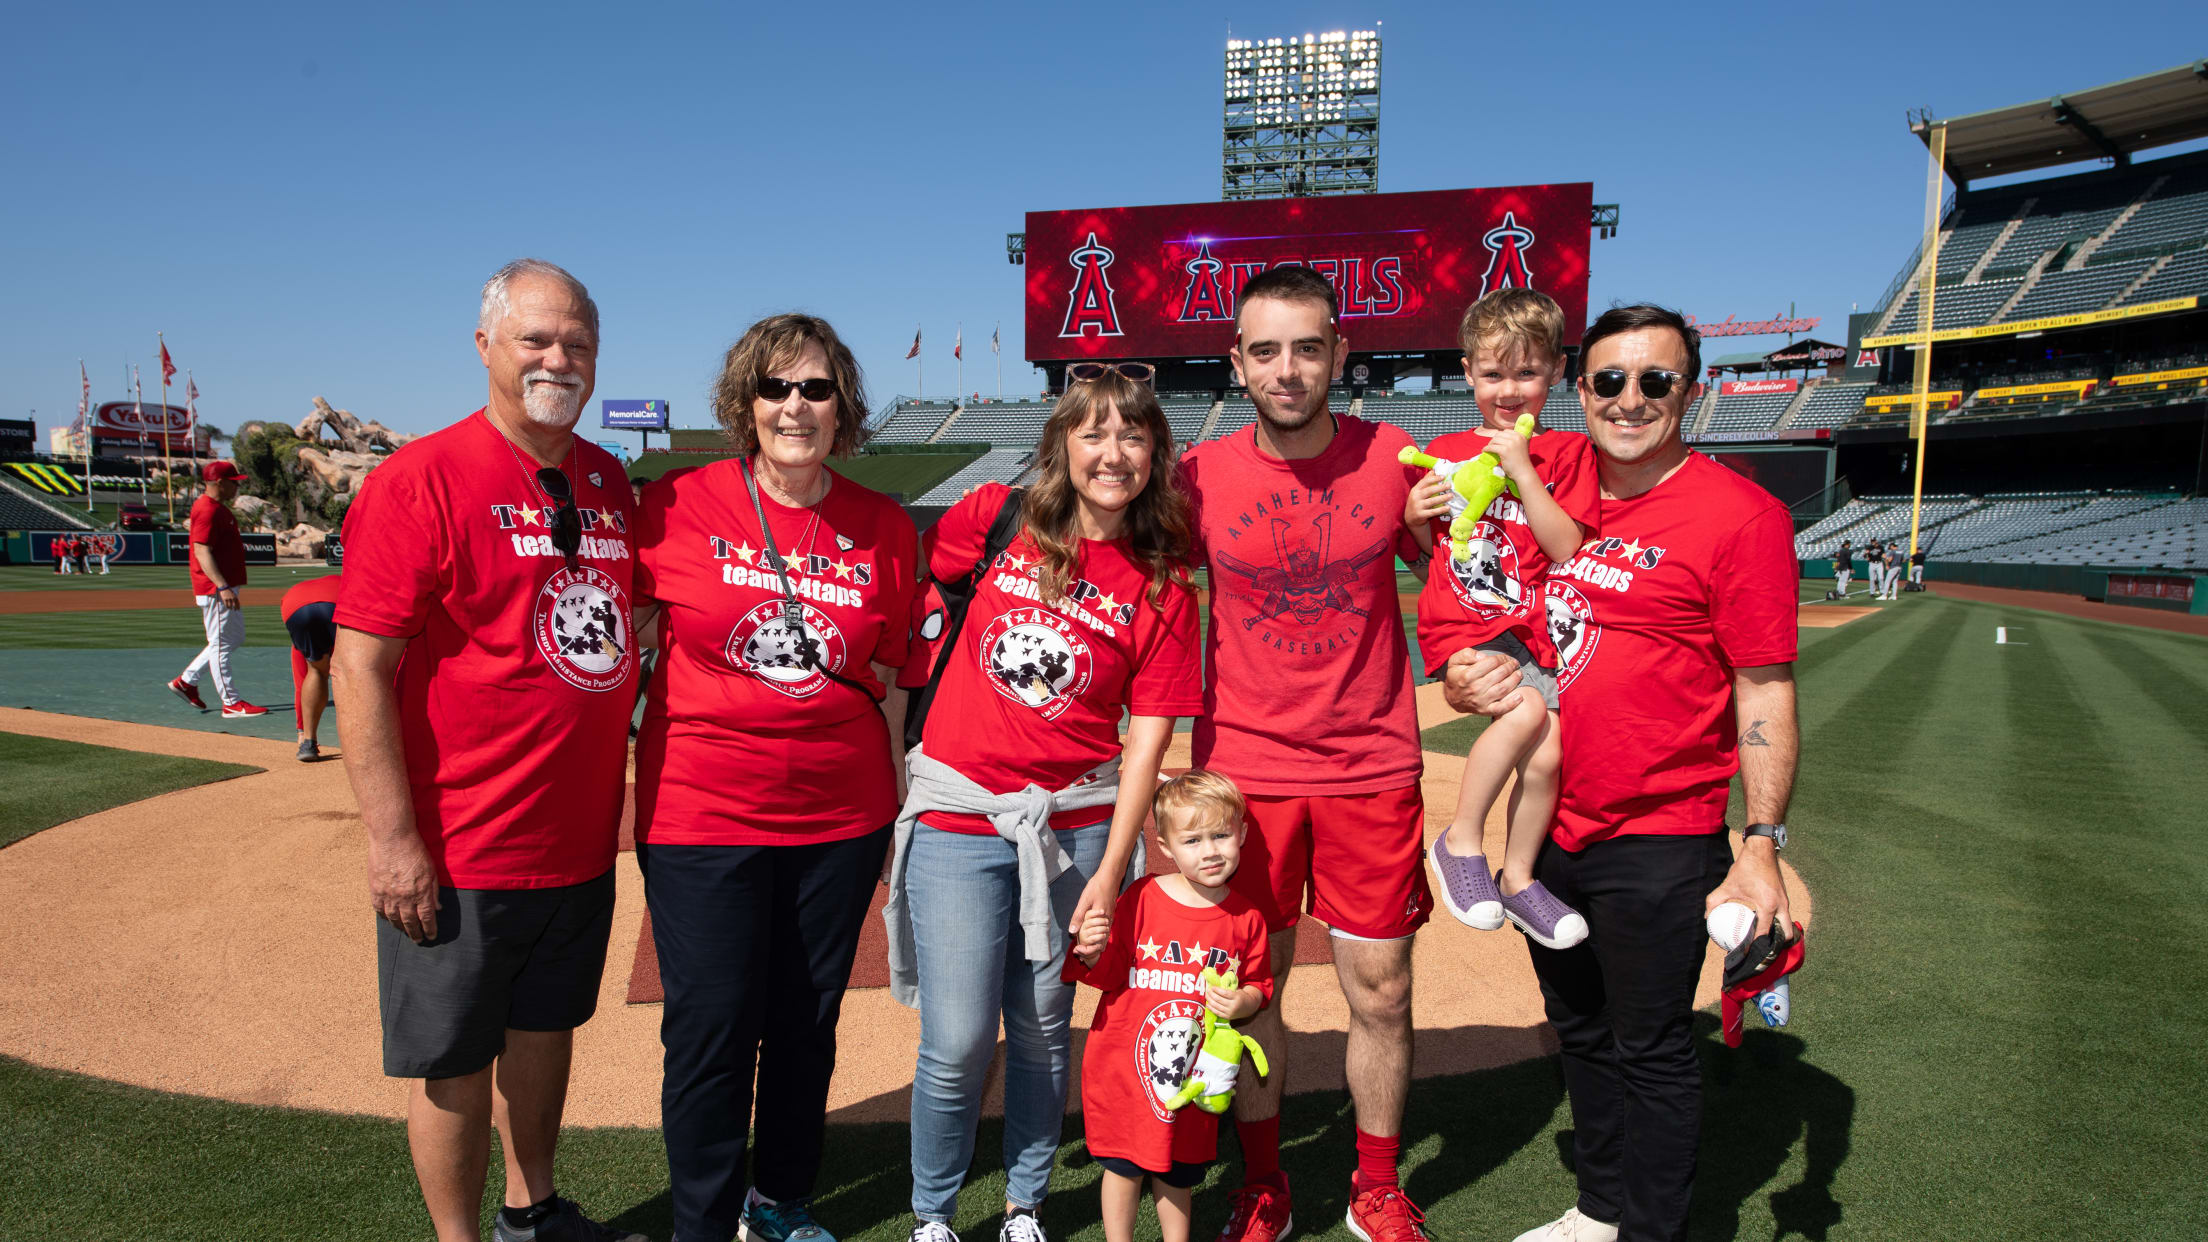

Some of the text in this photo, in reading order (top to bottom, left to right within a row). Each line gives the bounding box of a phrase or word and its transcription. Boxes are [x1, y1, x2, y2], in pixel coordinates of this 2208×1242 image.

[1177, 239, 1402, 321] ANLS
[1975, 325, 2018, 335] RESTAURANT
[2019, 322, 2038, 331] OPEN
[1811, 346, 1846, 360] PATIO
[1732, 379, 1787, 393] Budweiser
[1686, 433, 1697, 442] BY
[1699, 432, 1742, 442] SINCERELY
[1743, 432, 1779, 441] COLLINS
[1350, 503, 1375, 530] CA
[511, 533, 629, 561] tea4taps
[1591, 536, 1667, 570] PS
[1546, 556, 1634, 593] ms4taps
[1262, 626, 1359, 655] BASEBALL
[1568, 630, 1597, 675] SURVIVORS
[789, 678, 823, 694] PROGRAM
[1129, 966, 1207, 996] teams4
